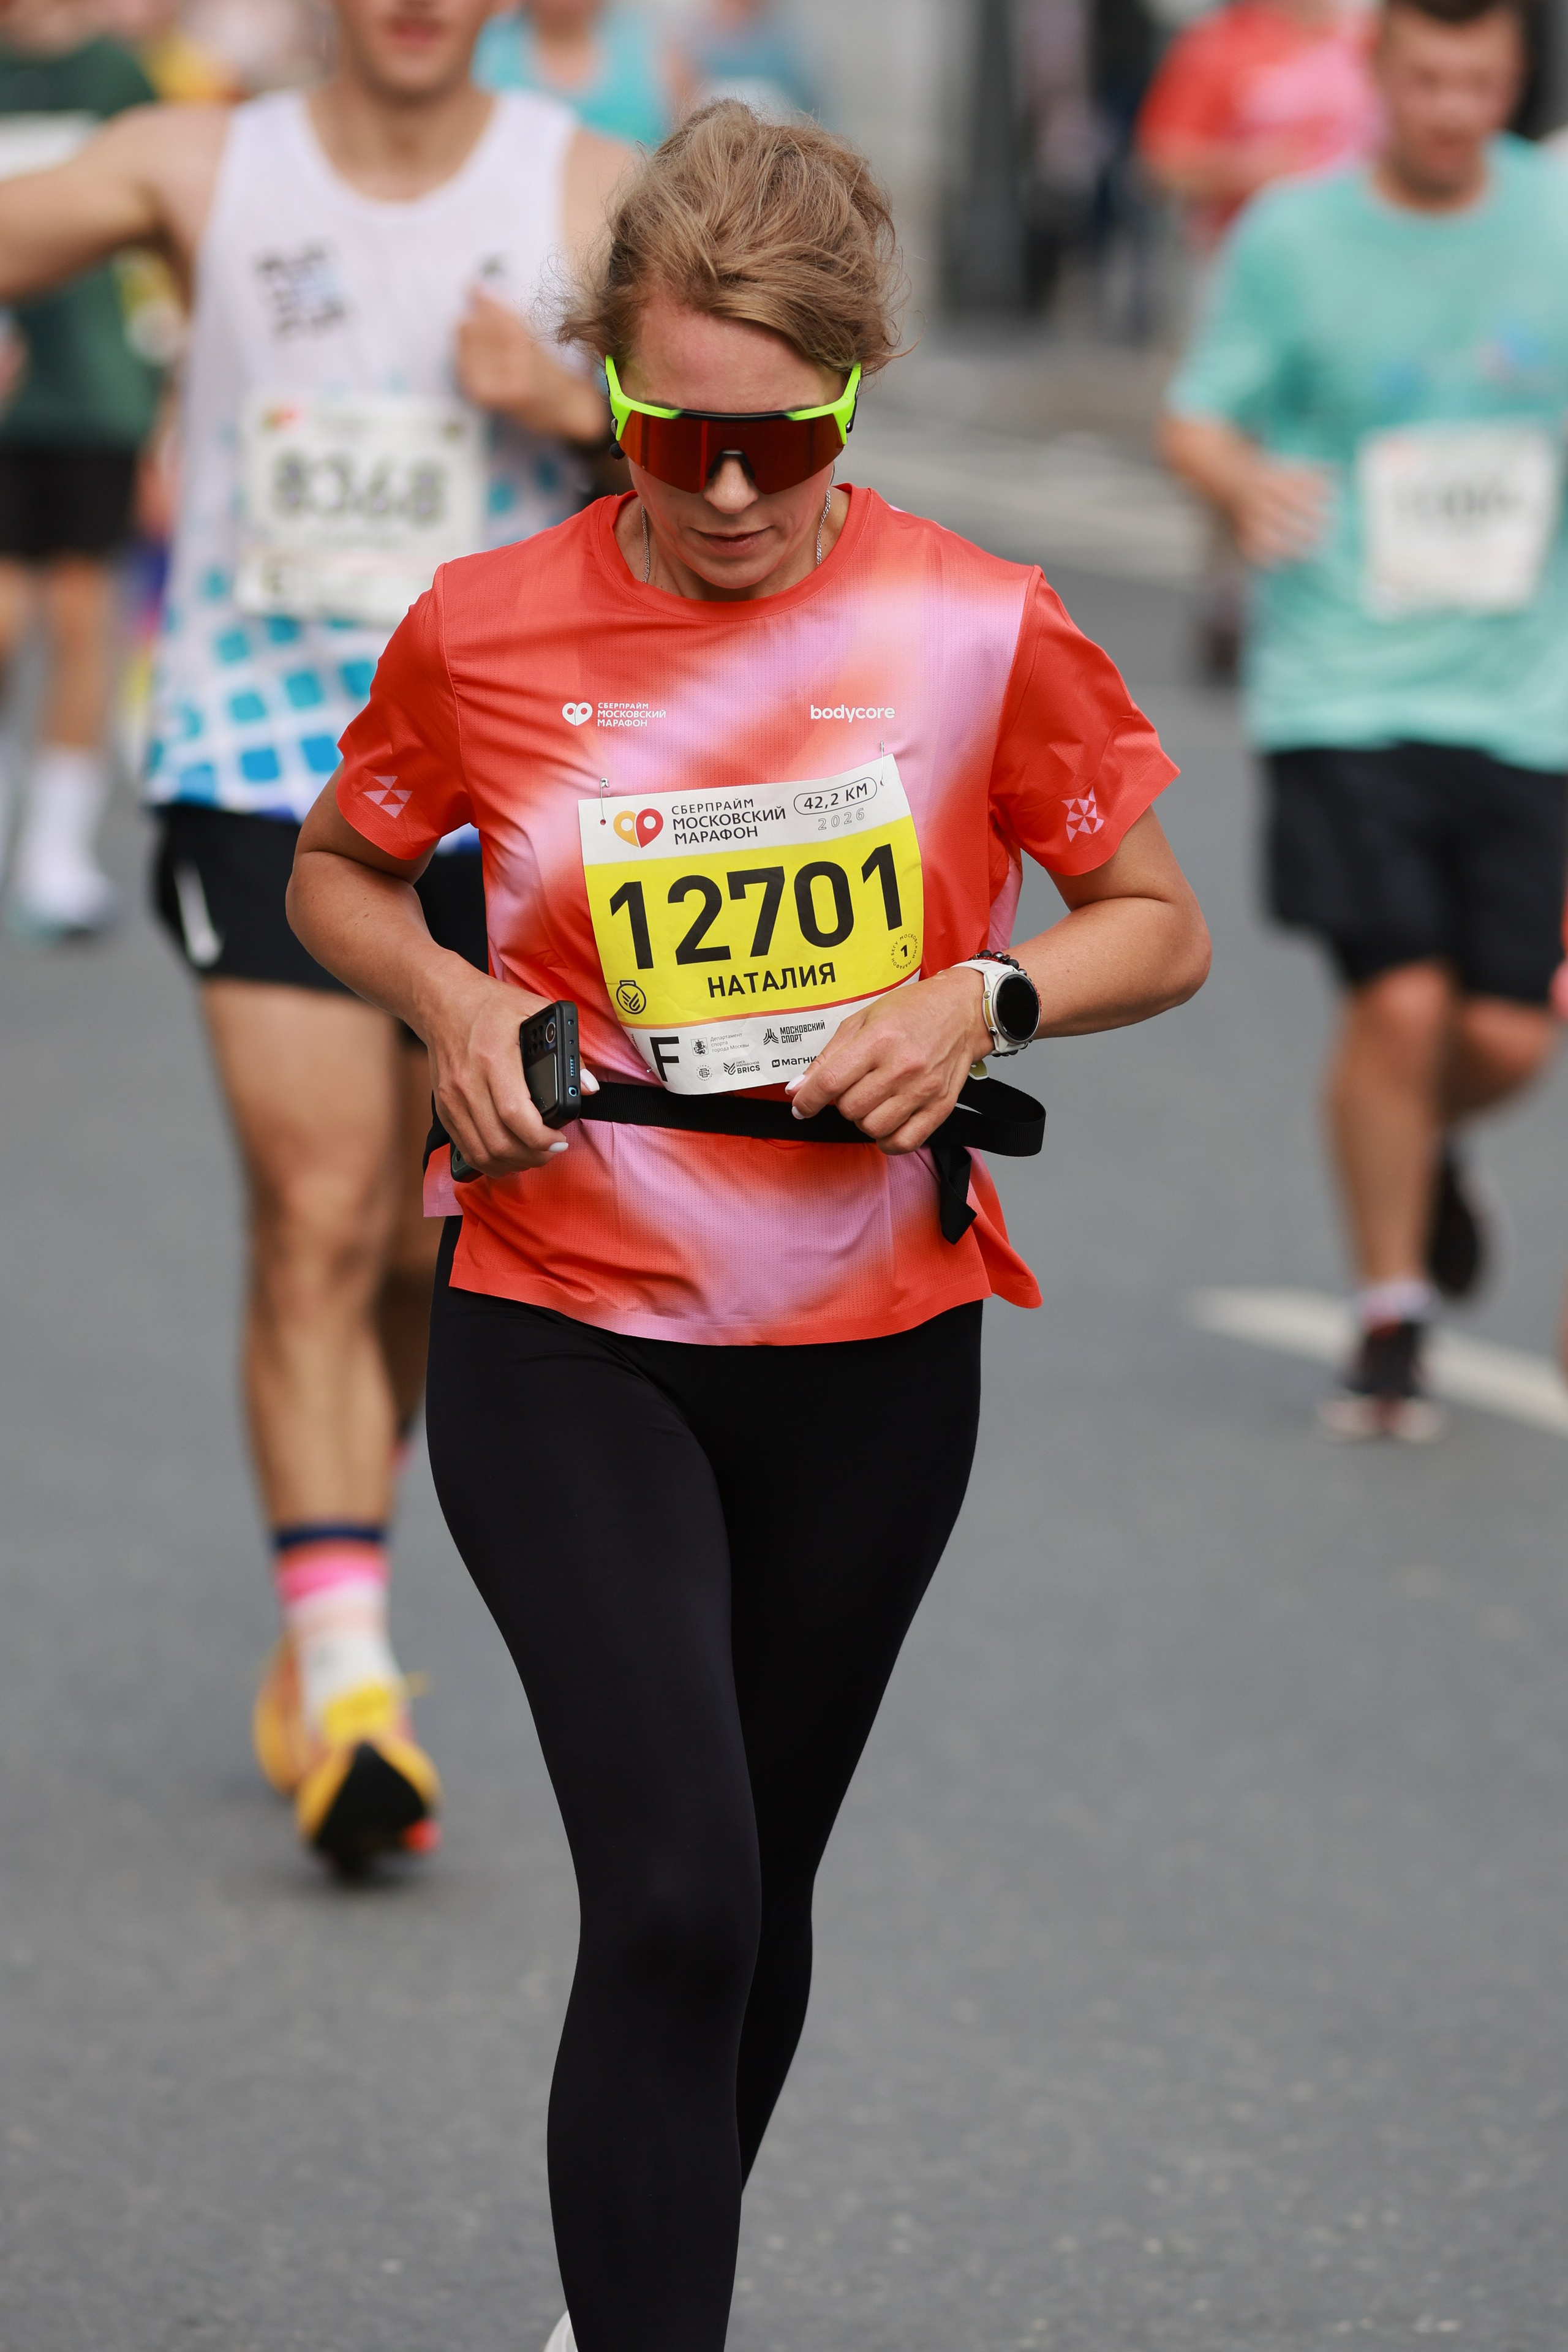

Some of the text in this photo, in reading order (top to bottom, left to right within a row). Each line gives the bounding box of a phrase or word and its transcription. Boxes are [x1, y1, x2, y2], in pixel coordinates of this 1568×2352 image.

[597, 709, 666, 718] МОСКОВСКИЙ
[810, 704, 895, 723] bodycore
[671, 798, 754, 815] СБЕРПРАЙМ
[804, 793, 839, 809] 42,2
[673, 806, 786, 831] МОСКОВСКИЙ
[818, 807, 865, 831] 2026
[674, 826, 758, 845] МАРАФОН
[609, 843, 903, 970] 12701
[900, 944, 908, 957] 1
[707, 962, 836, 998] НАТАЛИЯ
[780, 1020, 826, 1035] МОСКОВСКИЙ
[710, 1033, 742, 1042] Департамент
[781, 1034, 802, 1044] СПОРТ
[649, 1036, 680, 1082] F
[781, 1055, 820, 1066] магни
[737, 1065, 761, 1074] BRICS
